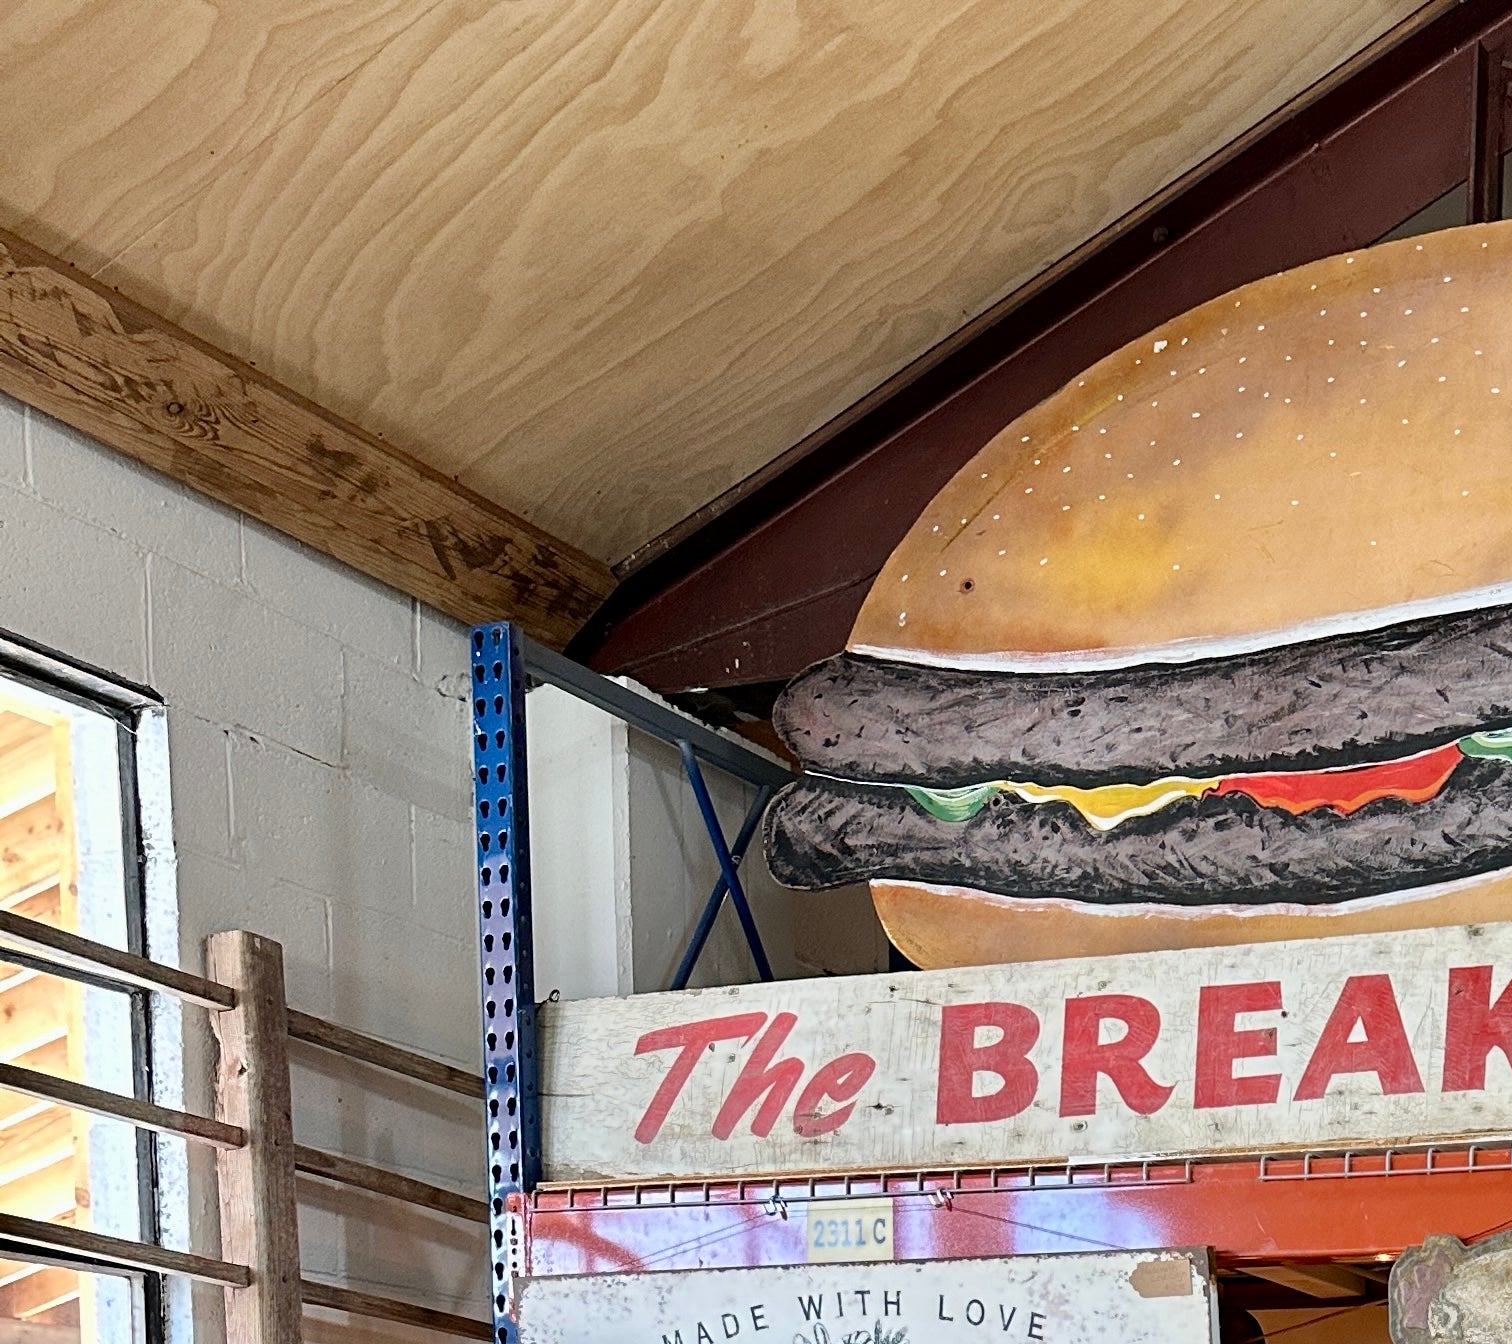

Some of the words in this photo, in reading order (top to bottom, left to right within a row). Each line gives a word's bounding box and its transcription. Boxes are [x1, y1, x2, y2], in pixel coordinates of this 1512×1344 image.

[633, 1010, 879, 1146] The
[799, 1289, 904, 1323] WITH
[936, 1292, 1049, 1341] LOVE
